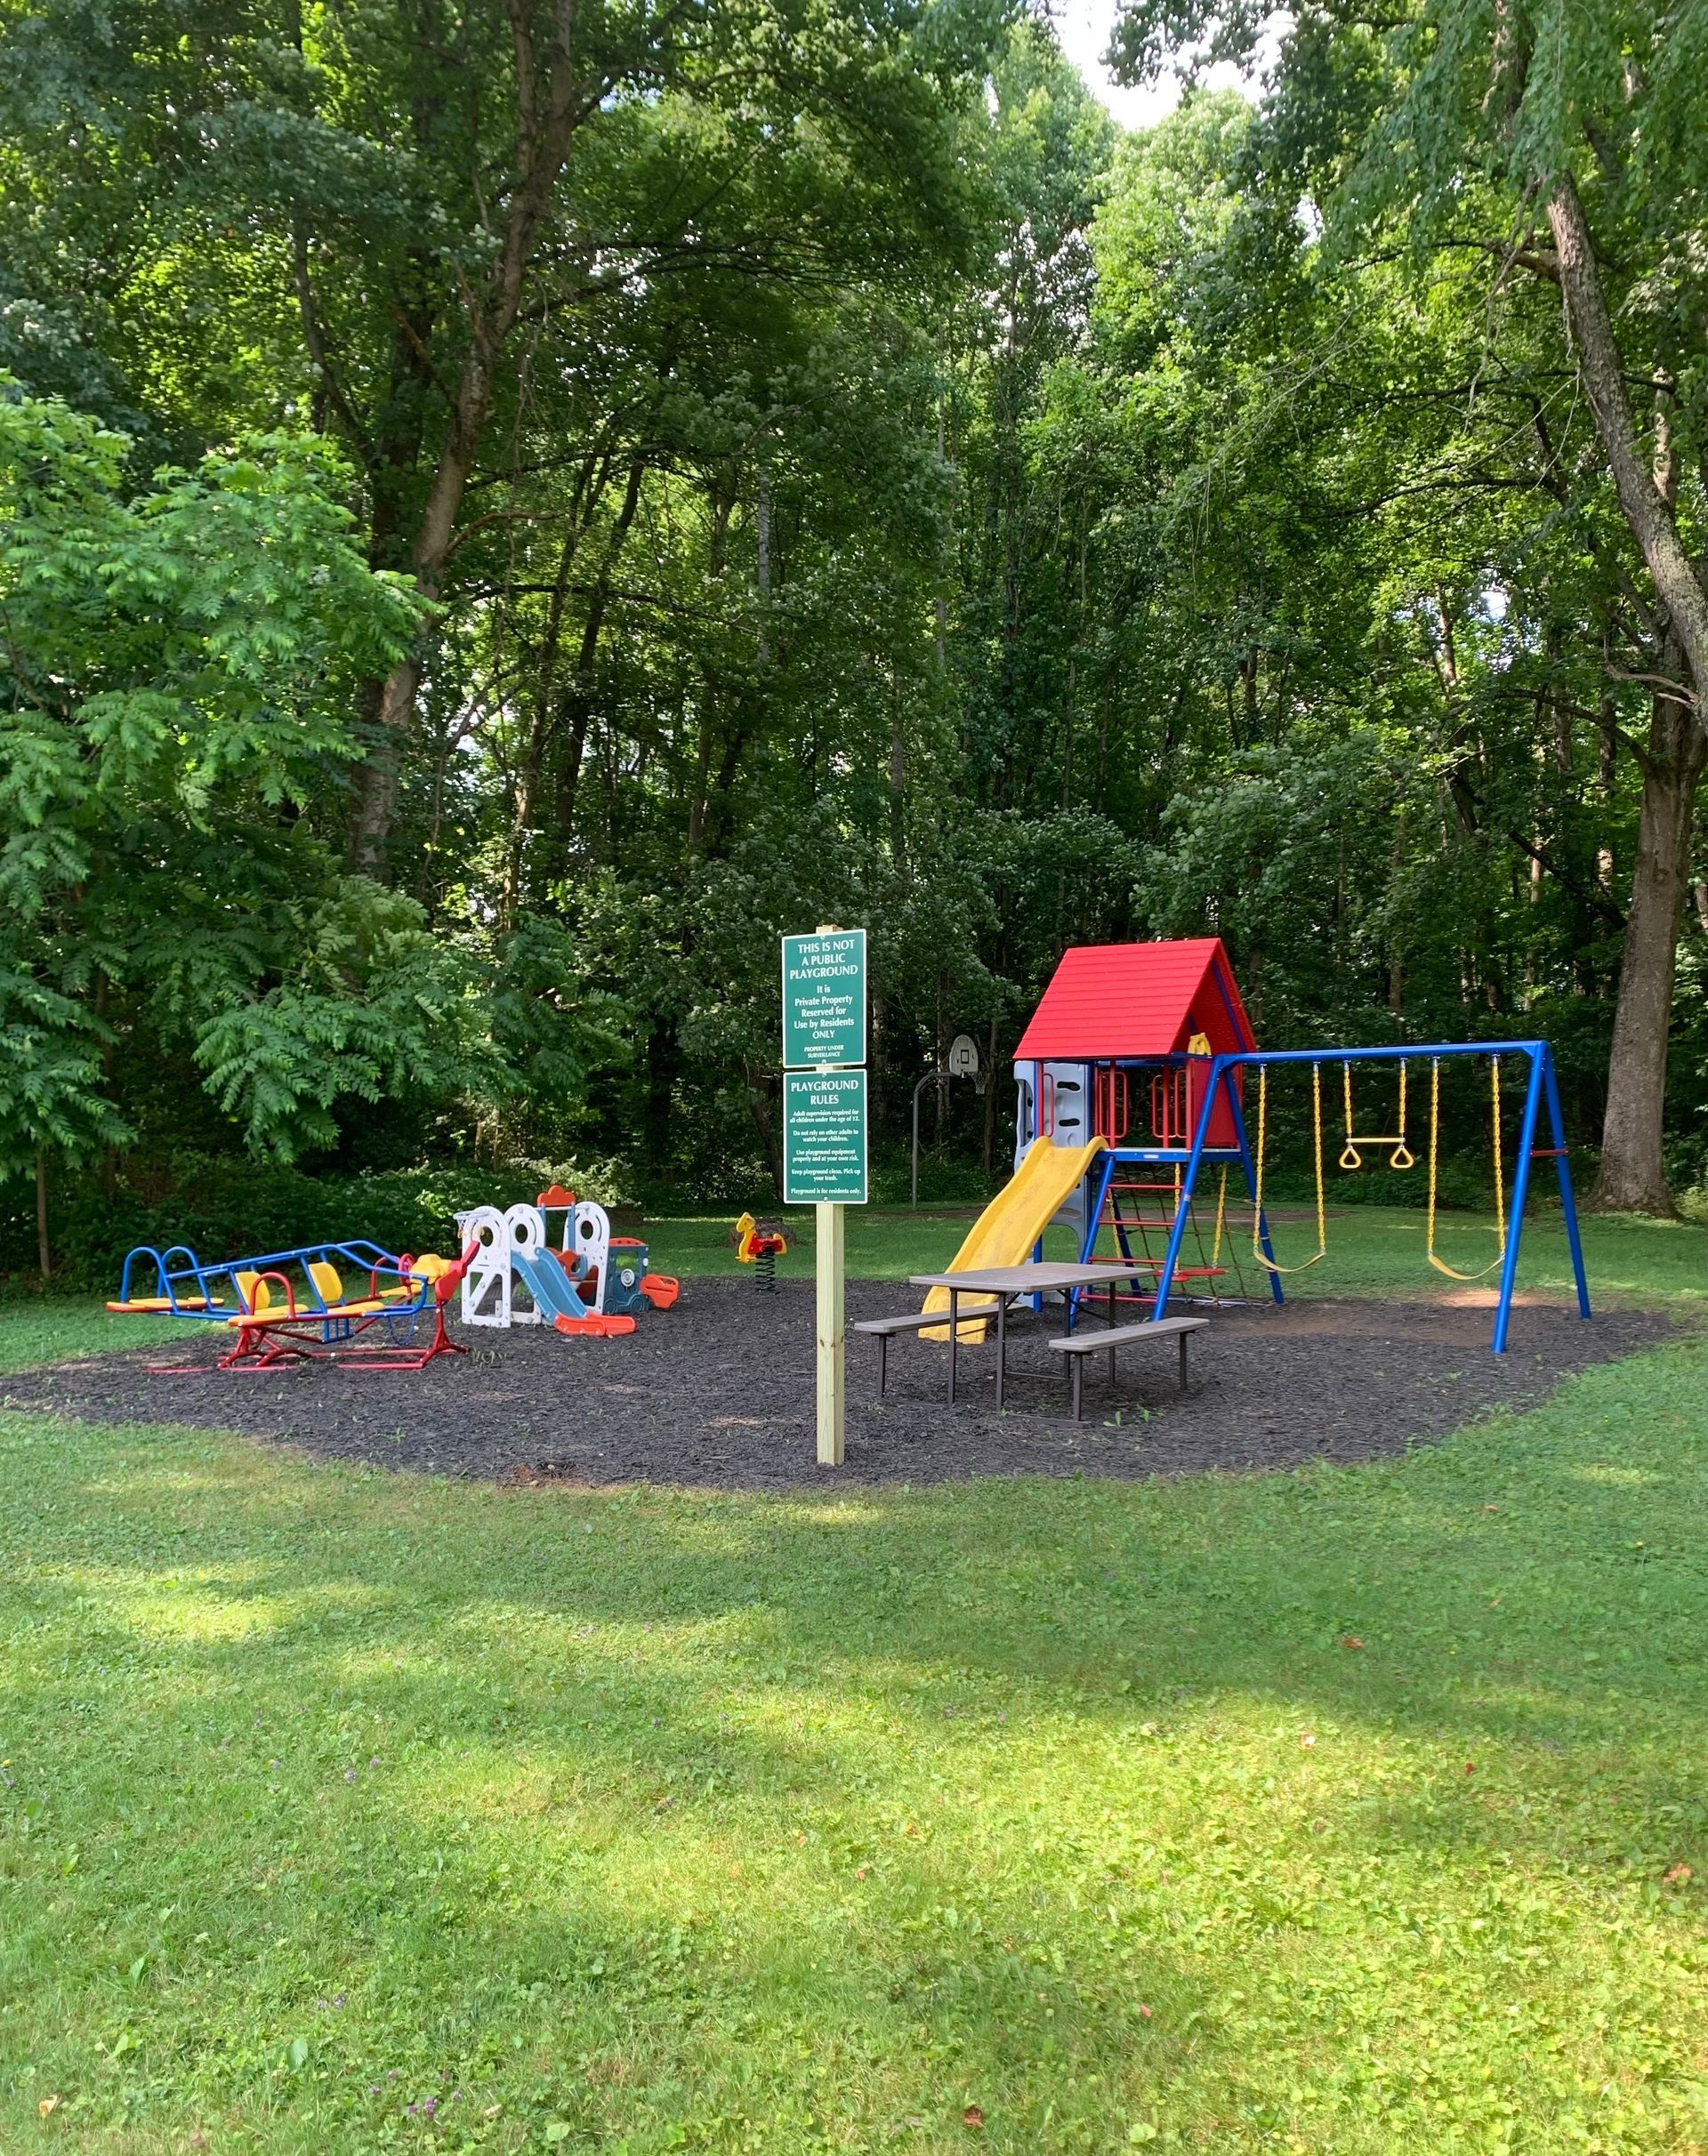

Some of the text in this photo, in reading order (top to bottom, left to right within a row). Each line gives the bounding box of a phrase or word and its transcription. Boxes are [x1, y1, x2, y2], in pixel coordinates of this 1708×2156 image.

[798, 939, 855, 953] THIS IS NOT
[802, 953, 846, 966] A PUBLIC
[790, 965, 858, 979] PLAYGROUND
[817, 985, 830, 994] It is
[795, 995, 853, 1006] Private Property
[802, 1007, 846, 1017] Reserved for
[794, 1018, 854, 1030] Use by Residents
[812, 1030, 834, 1039] ONLY
[791, 1080, 858, 1092] PLAYGROUND
[810, 1095, 839, 1105] RULES
[807, 1110, 831, 1118] supervision
